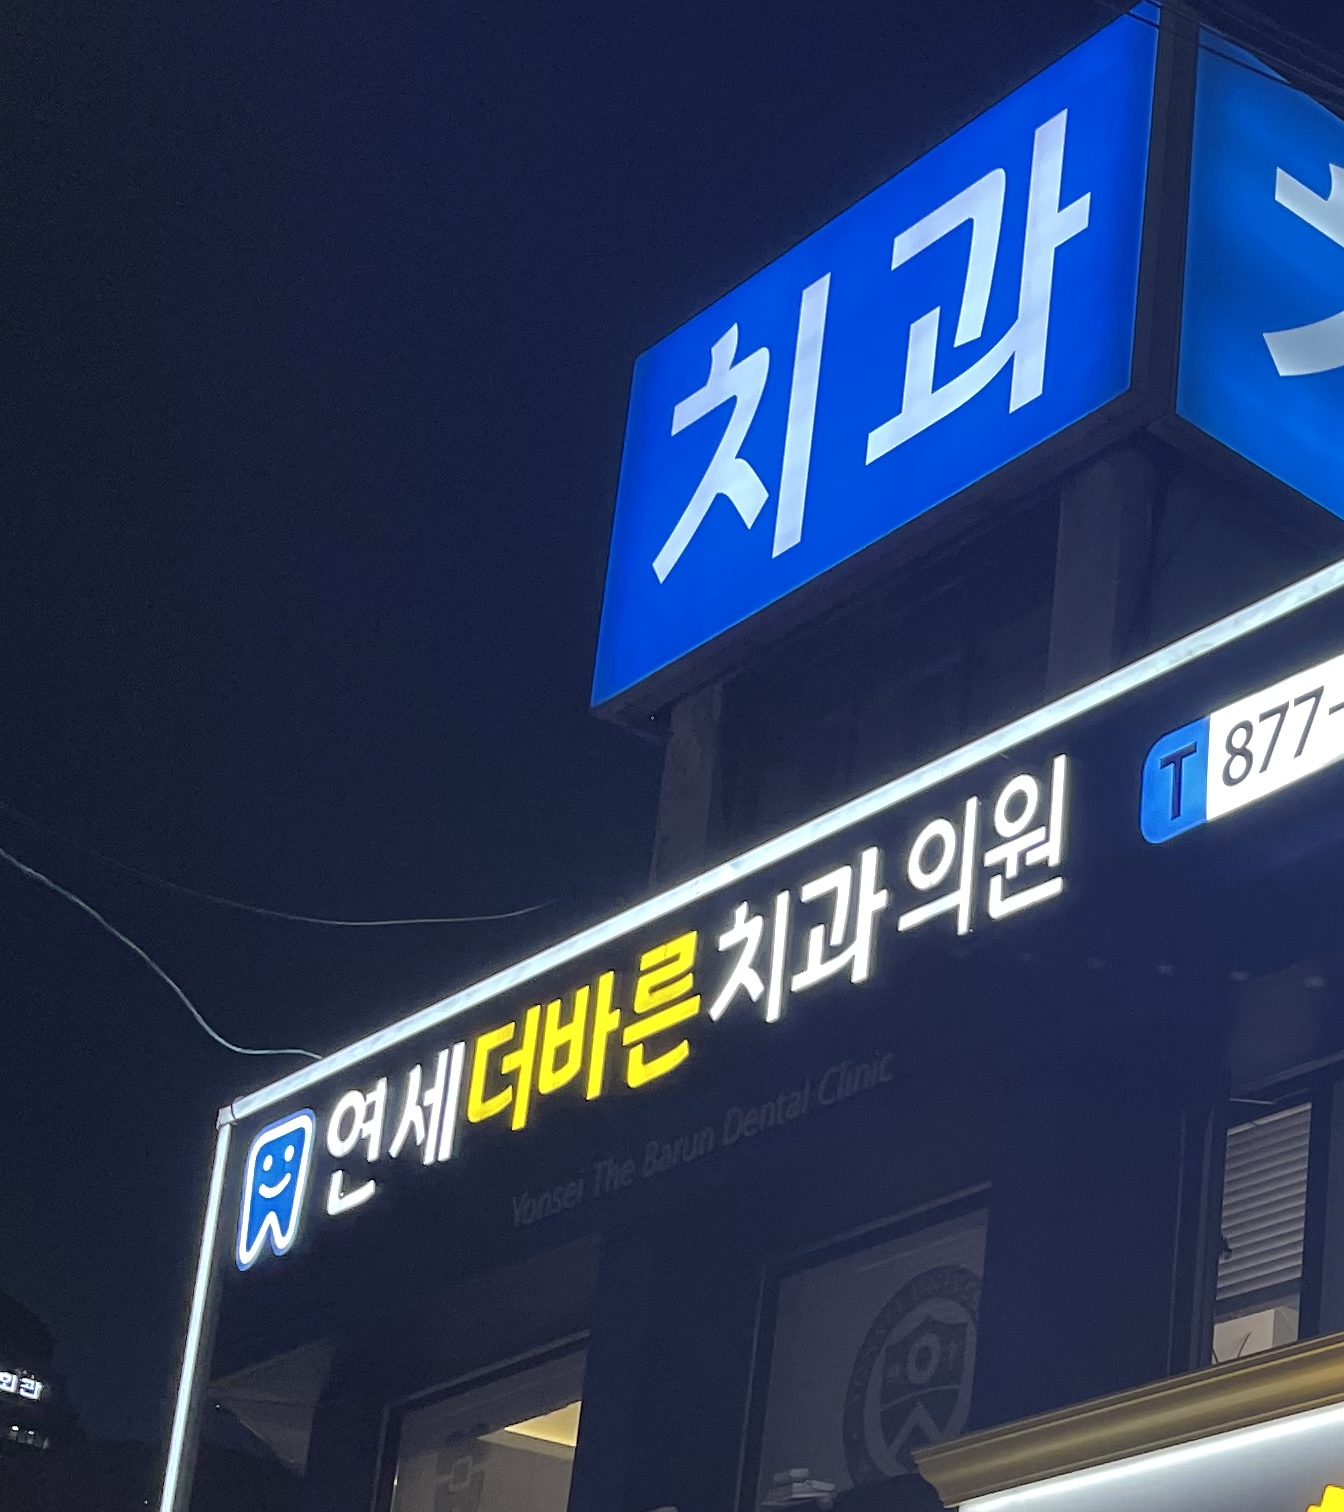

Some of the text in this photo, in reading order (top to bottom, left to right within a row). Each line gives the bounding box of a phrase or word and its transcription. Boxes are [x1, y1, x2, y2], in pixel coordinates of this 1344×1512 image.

[652, 107, 1092, 584] 치과
[326, 754, 1069, 1216] 연세더바른치과의원
[510, 1048, 895, 1229] Yonsei The Barun Dental Clinic
